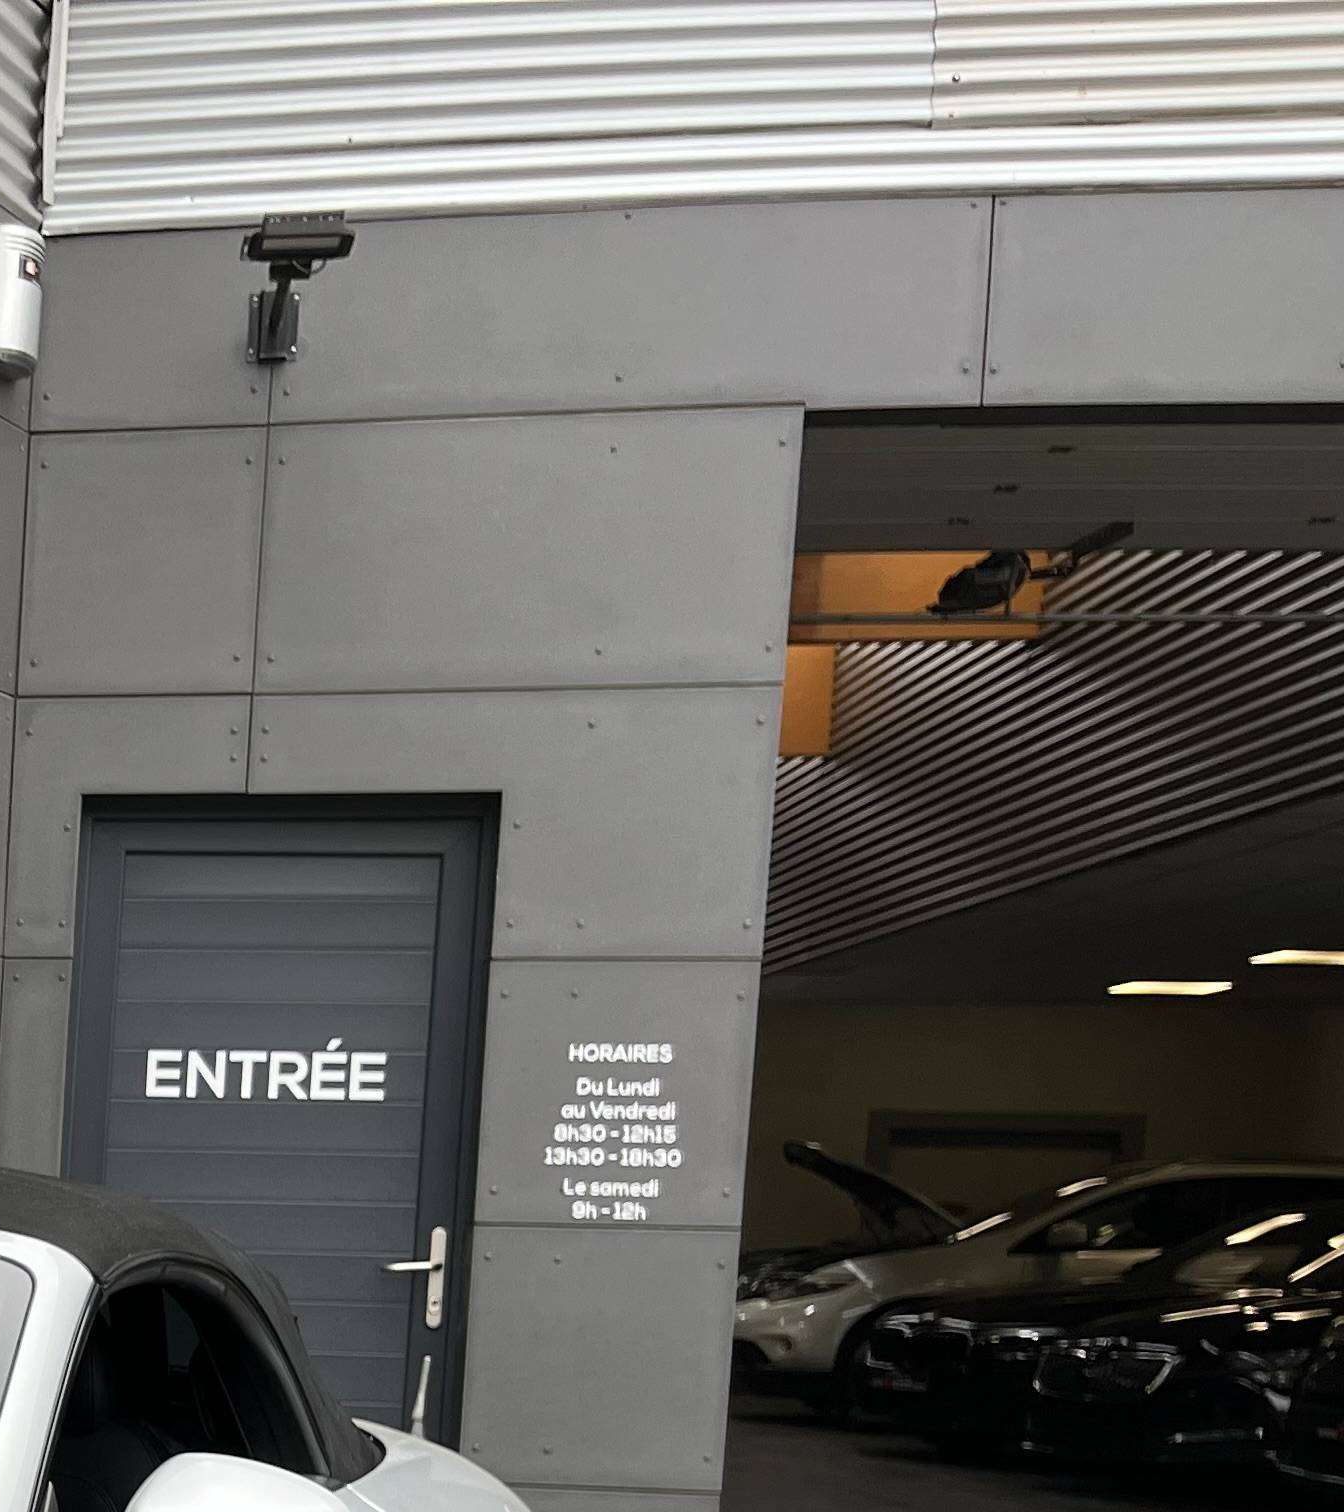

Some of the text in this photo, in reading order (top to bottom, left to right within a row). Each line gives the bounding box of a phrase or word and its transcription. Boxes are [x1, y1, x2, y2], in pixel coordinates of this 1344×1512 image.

[568, 1043, 673, 1063] HORAIRES
[145, 1037, 387, 1101] ENTRÉE
[576, 1077, 660, 1097] Du Lundi
[561, 1101, 676, 1121] au Vendredi
[544, 1147, 605, 1166] 13h30
[563, 1178, 659, 1198] Le samedi
[613, 1202, 647, 1221] 12h
